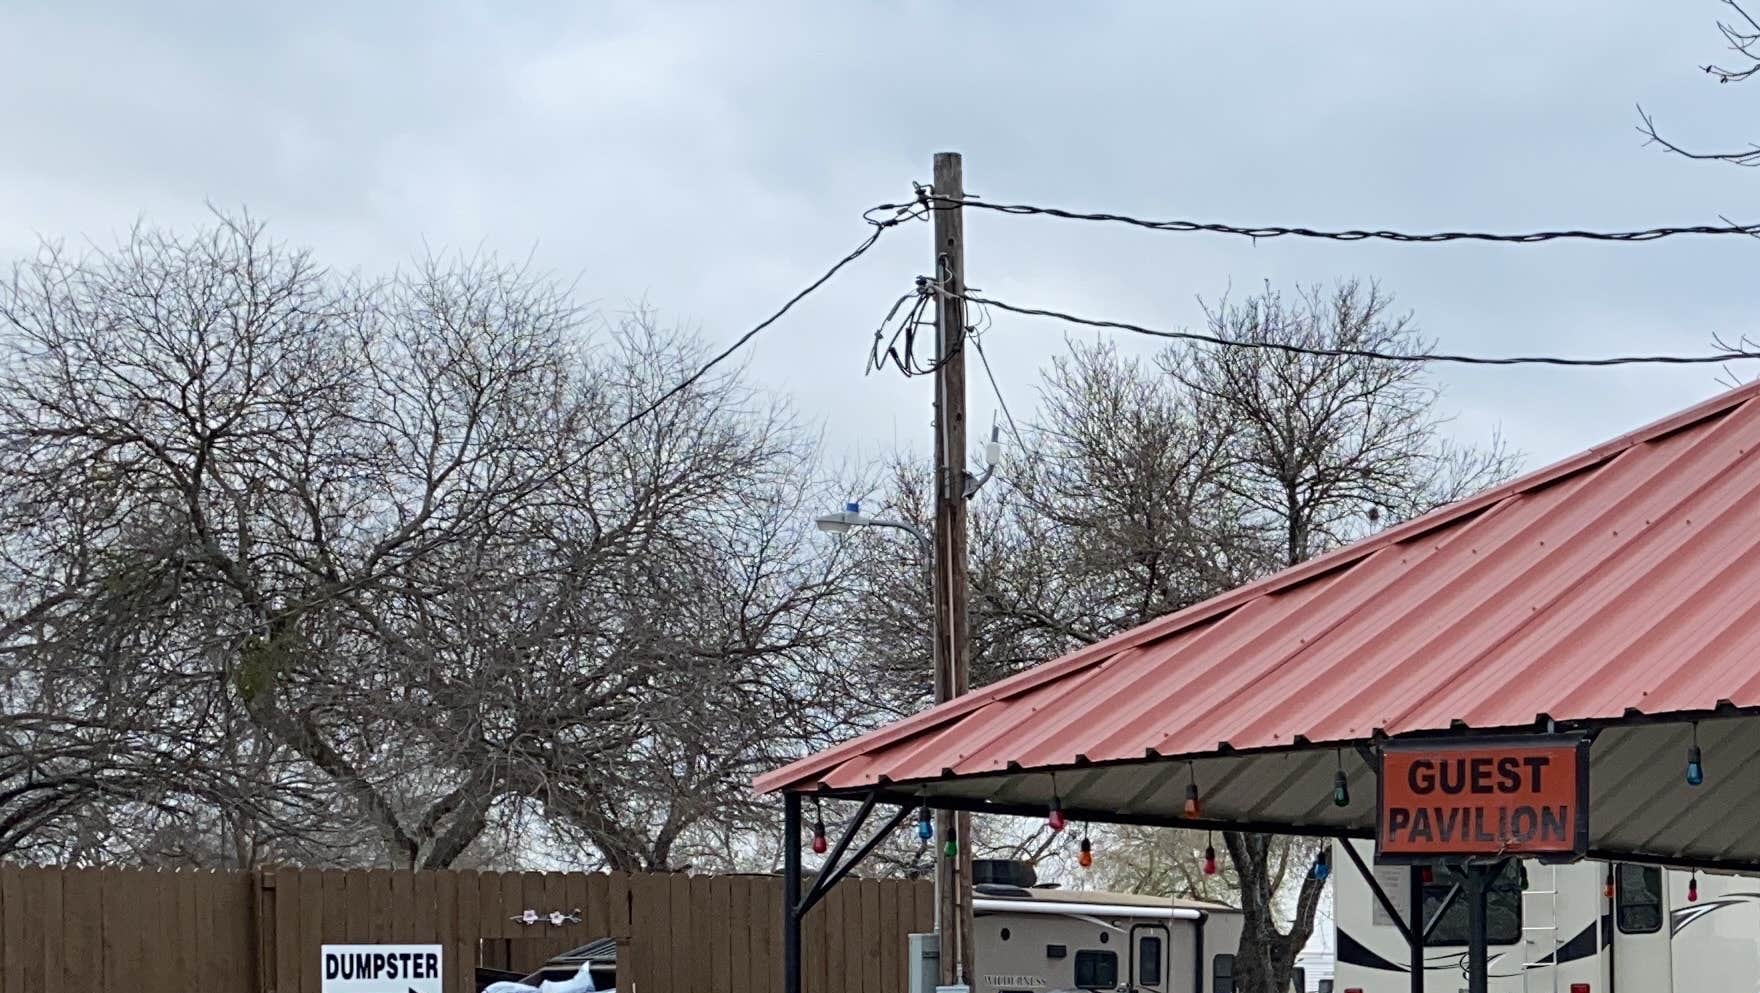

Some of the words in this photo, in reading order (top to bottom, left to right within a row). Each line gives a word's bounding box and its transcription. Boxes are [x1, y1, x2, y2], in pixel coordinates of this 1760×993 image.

[1408, 757, 1550, 794] GUEST
[1389, 806, 1568, 842] PAVILION
[326, 953, 438, 980] DUMPSTER
[984, 975, 1047, 986] WILDERNESS
